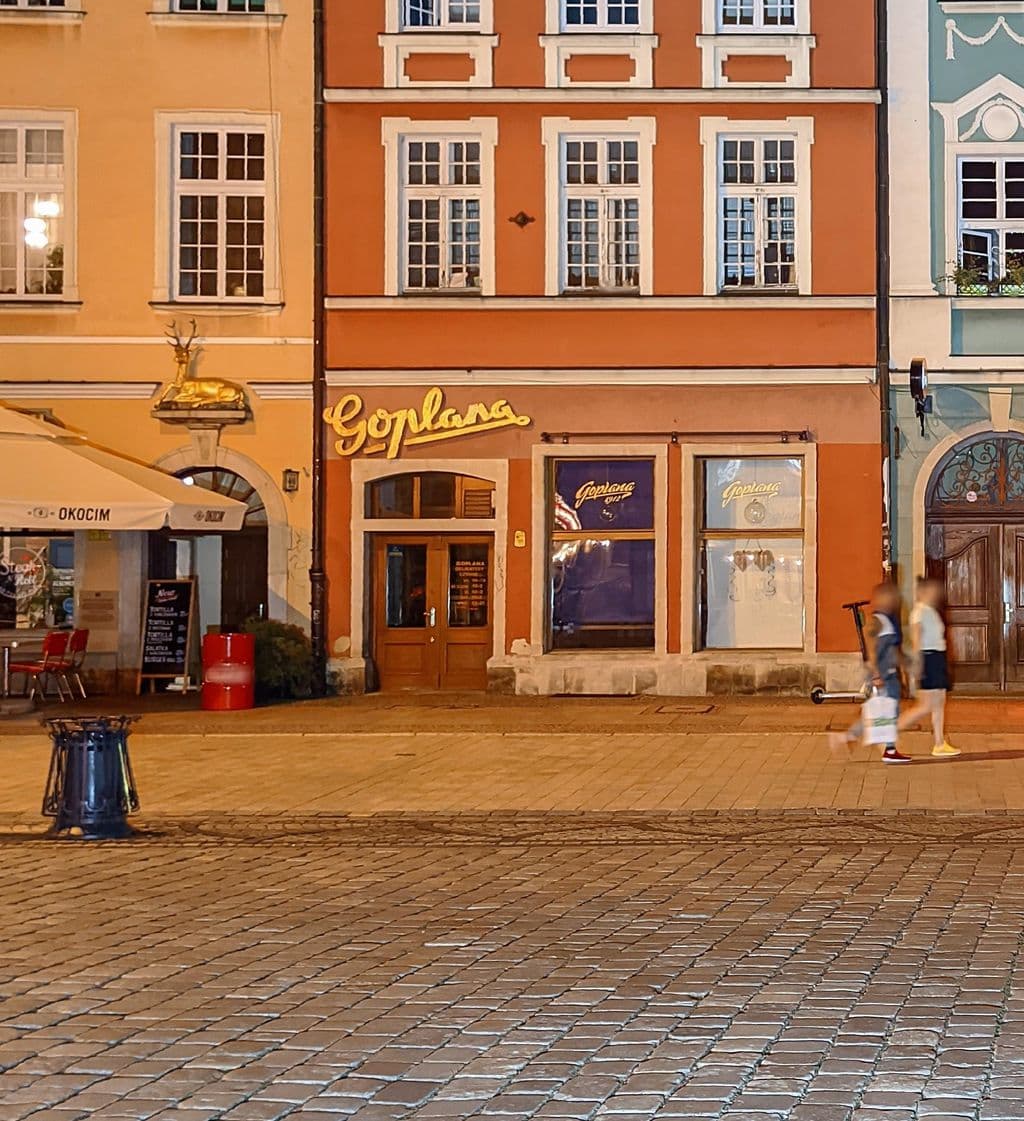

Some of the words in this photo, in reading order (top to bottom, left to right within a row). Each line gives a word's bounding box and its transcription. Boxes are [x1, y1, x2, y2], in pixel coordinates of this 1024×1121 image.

[323, 387, 530, 459] Goplana
[574, 480, 636, 509] Goplana
[721, 480, 782, 508] Goplana
[58, 507, 111, 522] OKOCIM
